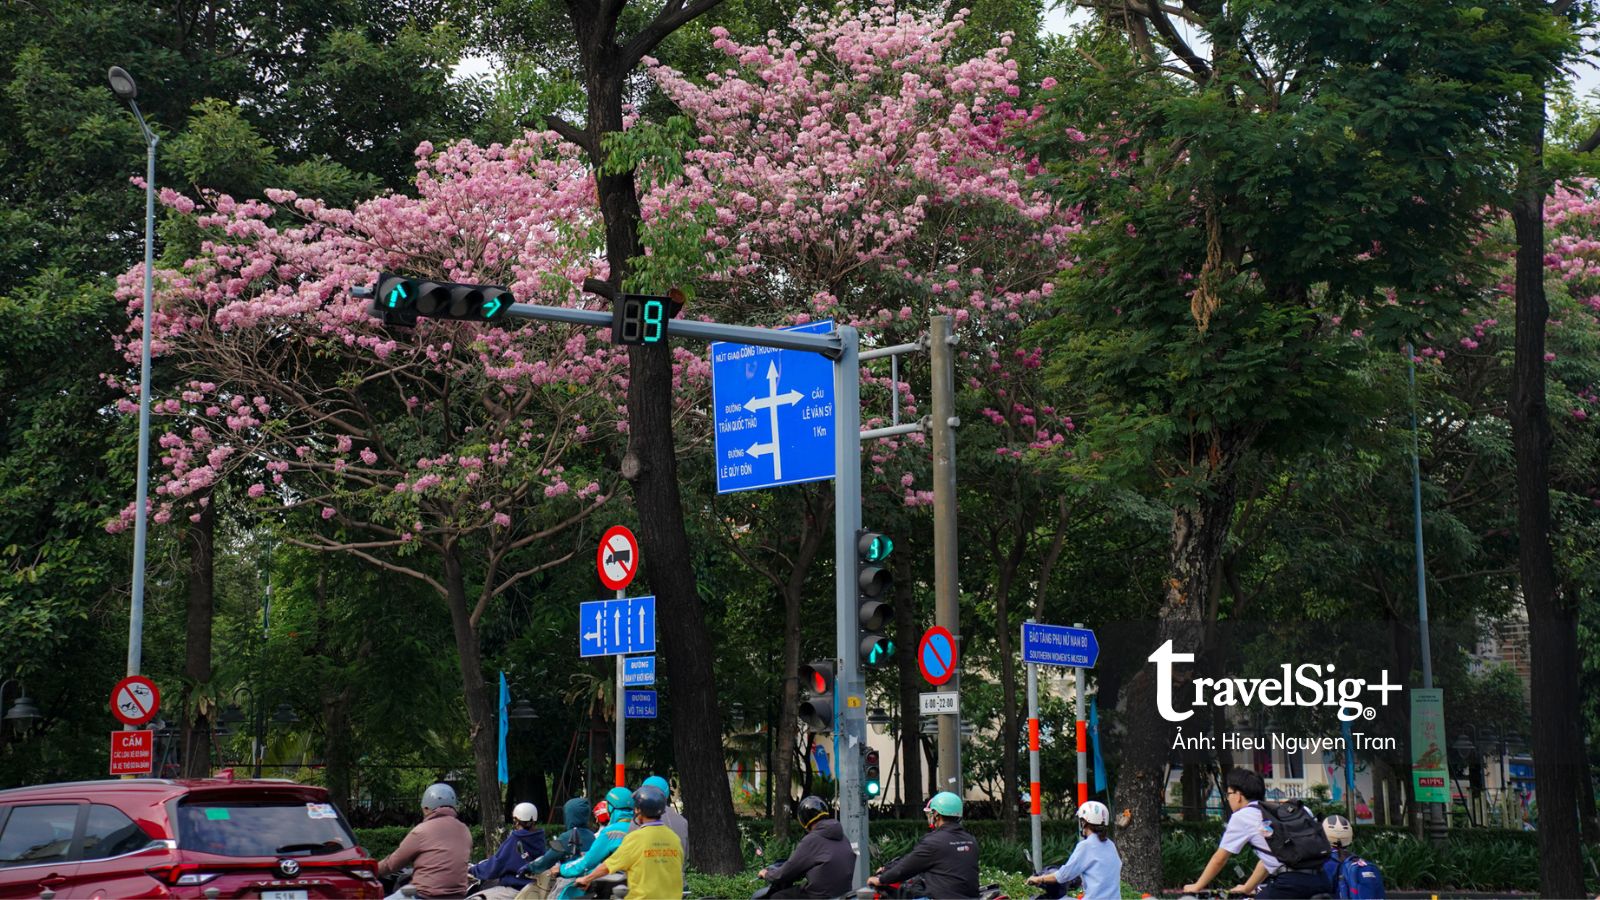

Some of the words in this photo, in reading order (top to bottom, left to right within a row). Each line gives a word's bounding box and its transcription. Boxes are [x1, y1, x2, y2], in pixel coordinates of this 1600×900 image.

[715, 351, 726, 362] NÚT
[727, 350, 740, 360] GIAO
[740, 345, 755, 358] CÔNG
[725, 403, 742, 414] ĐƯỜNG
[802, 406, 811, 420] LÊ
[811, 405, 824, 418] VĂN
[732, 416, 744, 431] QUỐC
[745, 415, 757, 429] THẢO
[817, 425, 827, 437] Km
[727, 447, 745, 459] ĐƯỜNG
[720, 465, 728, 478] LÊ
[740, 462, 752, 475] ĐÔN
[1071, 635, 1080, 647] NAM
[1029, 650, 1052, 661] SOUTHERN
[1071, 654, 1088, 664] MUSEUM
[122, 733, 143, 747] CẤM
